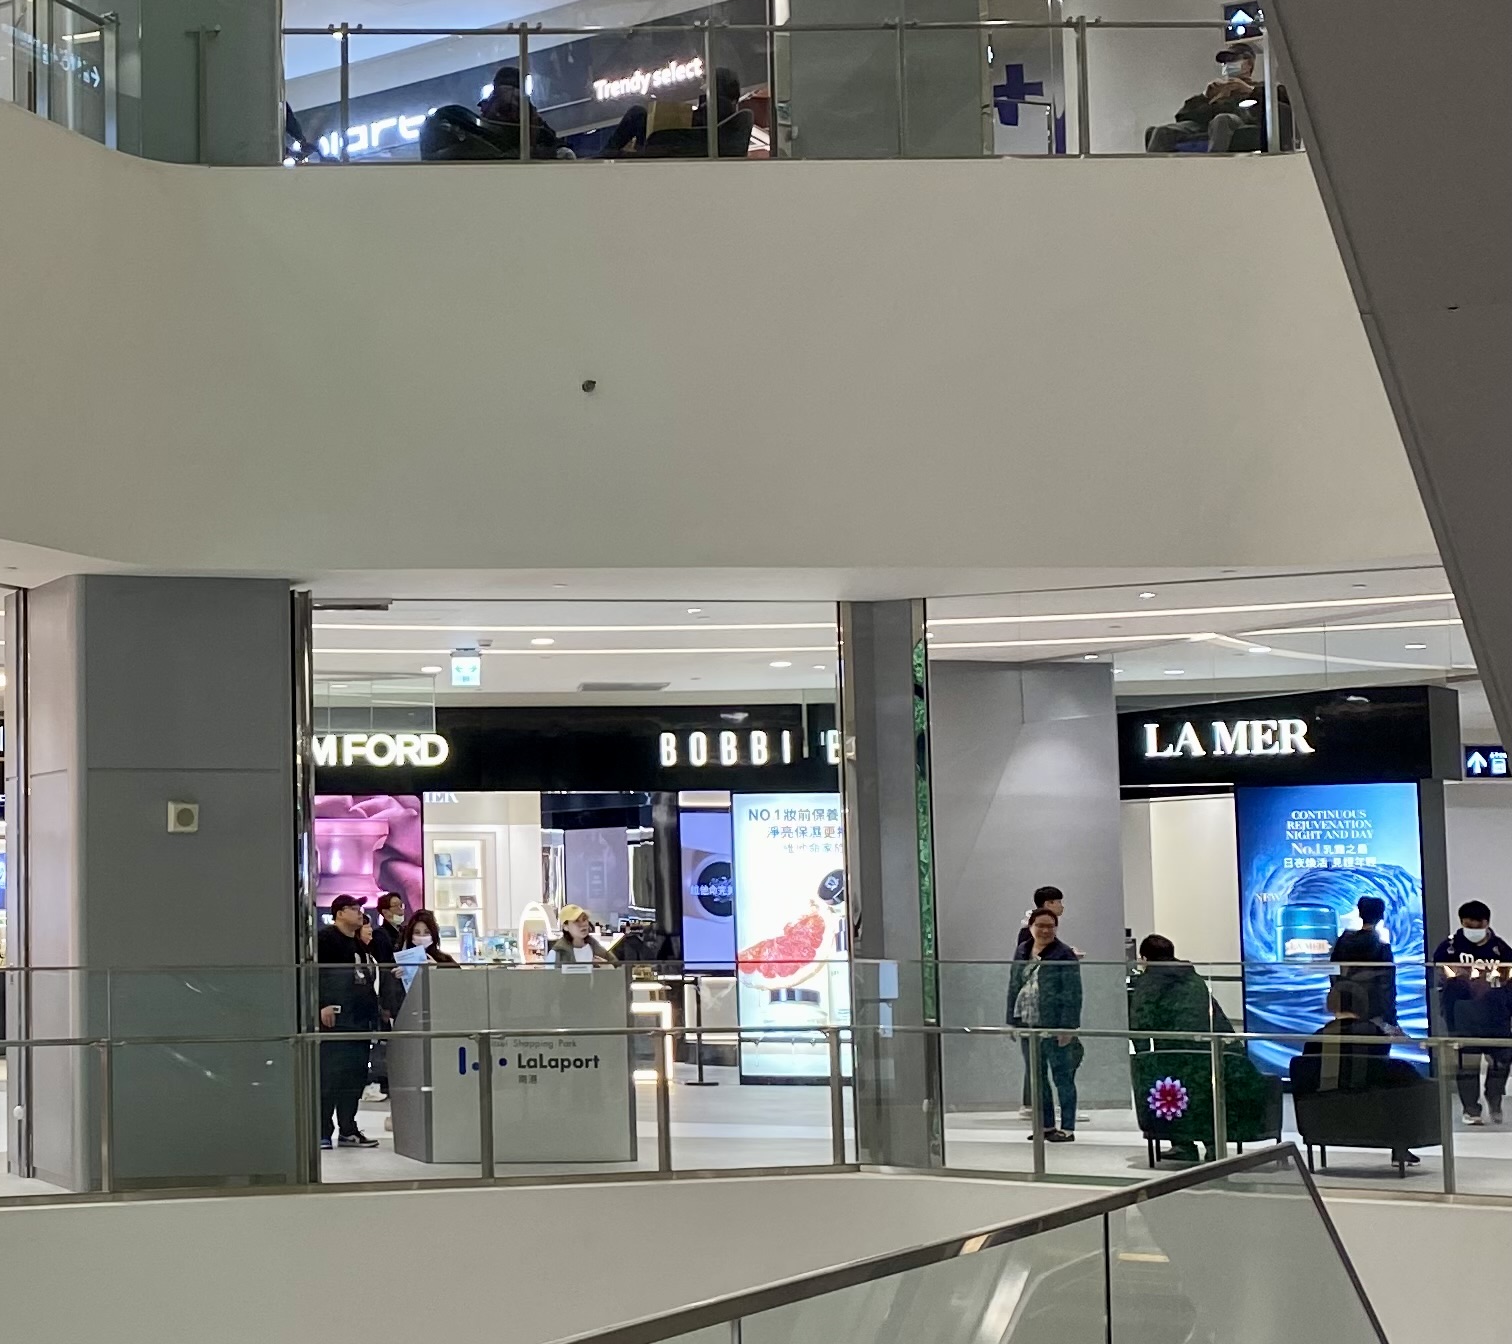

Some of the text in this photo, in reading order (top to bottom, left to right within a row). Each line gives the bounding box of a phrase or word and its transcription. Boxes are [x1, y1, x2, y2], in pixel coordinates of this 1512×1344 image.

[593, 57, 704, 102] Trendy select
[1143, 718, 1316, 757] LA MER
[342, 733, 450, 767] FORD
[659, 729, 791, 768] BOBBI
[1286, 819, 1373, 830] REJUVENATION
[1291, 809, 1367, 820] CONTINUOUS
[1286, 829, 1374, 840] NIGHT AND DAY
[513, 1039, 554, 1050] Shopping
[558, 1039, 577, 1048] Park
[517, 1053, 600, 1073] LaLaport
